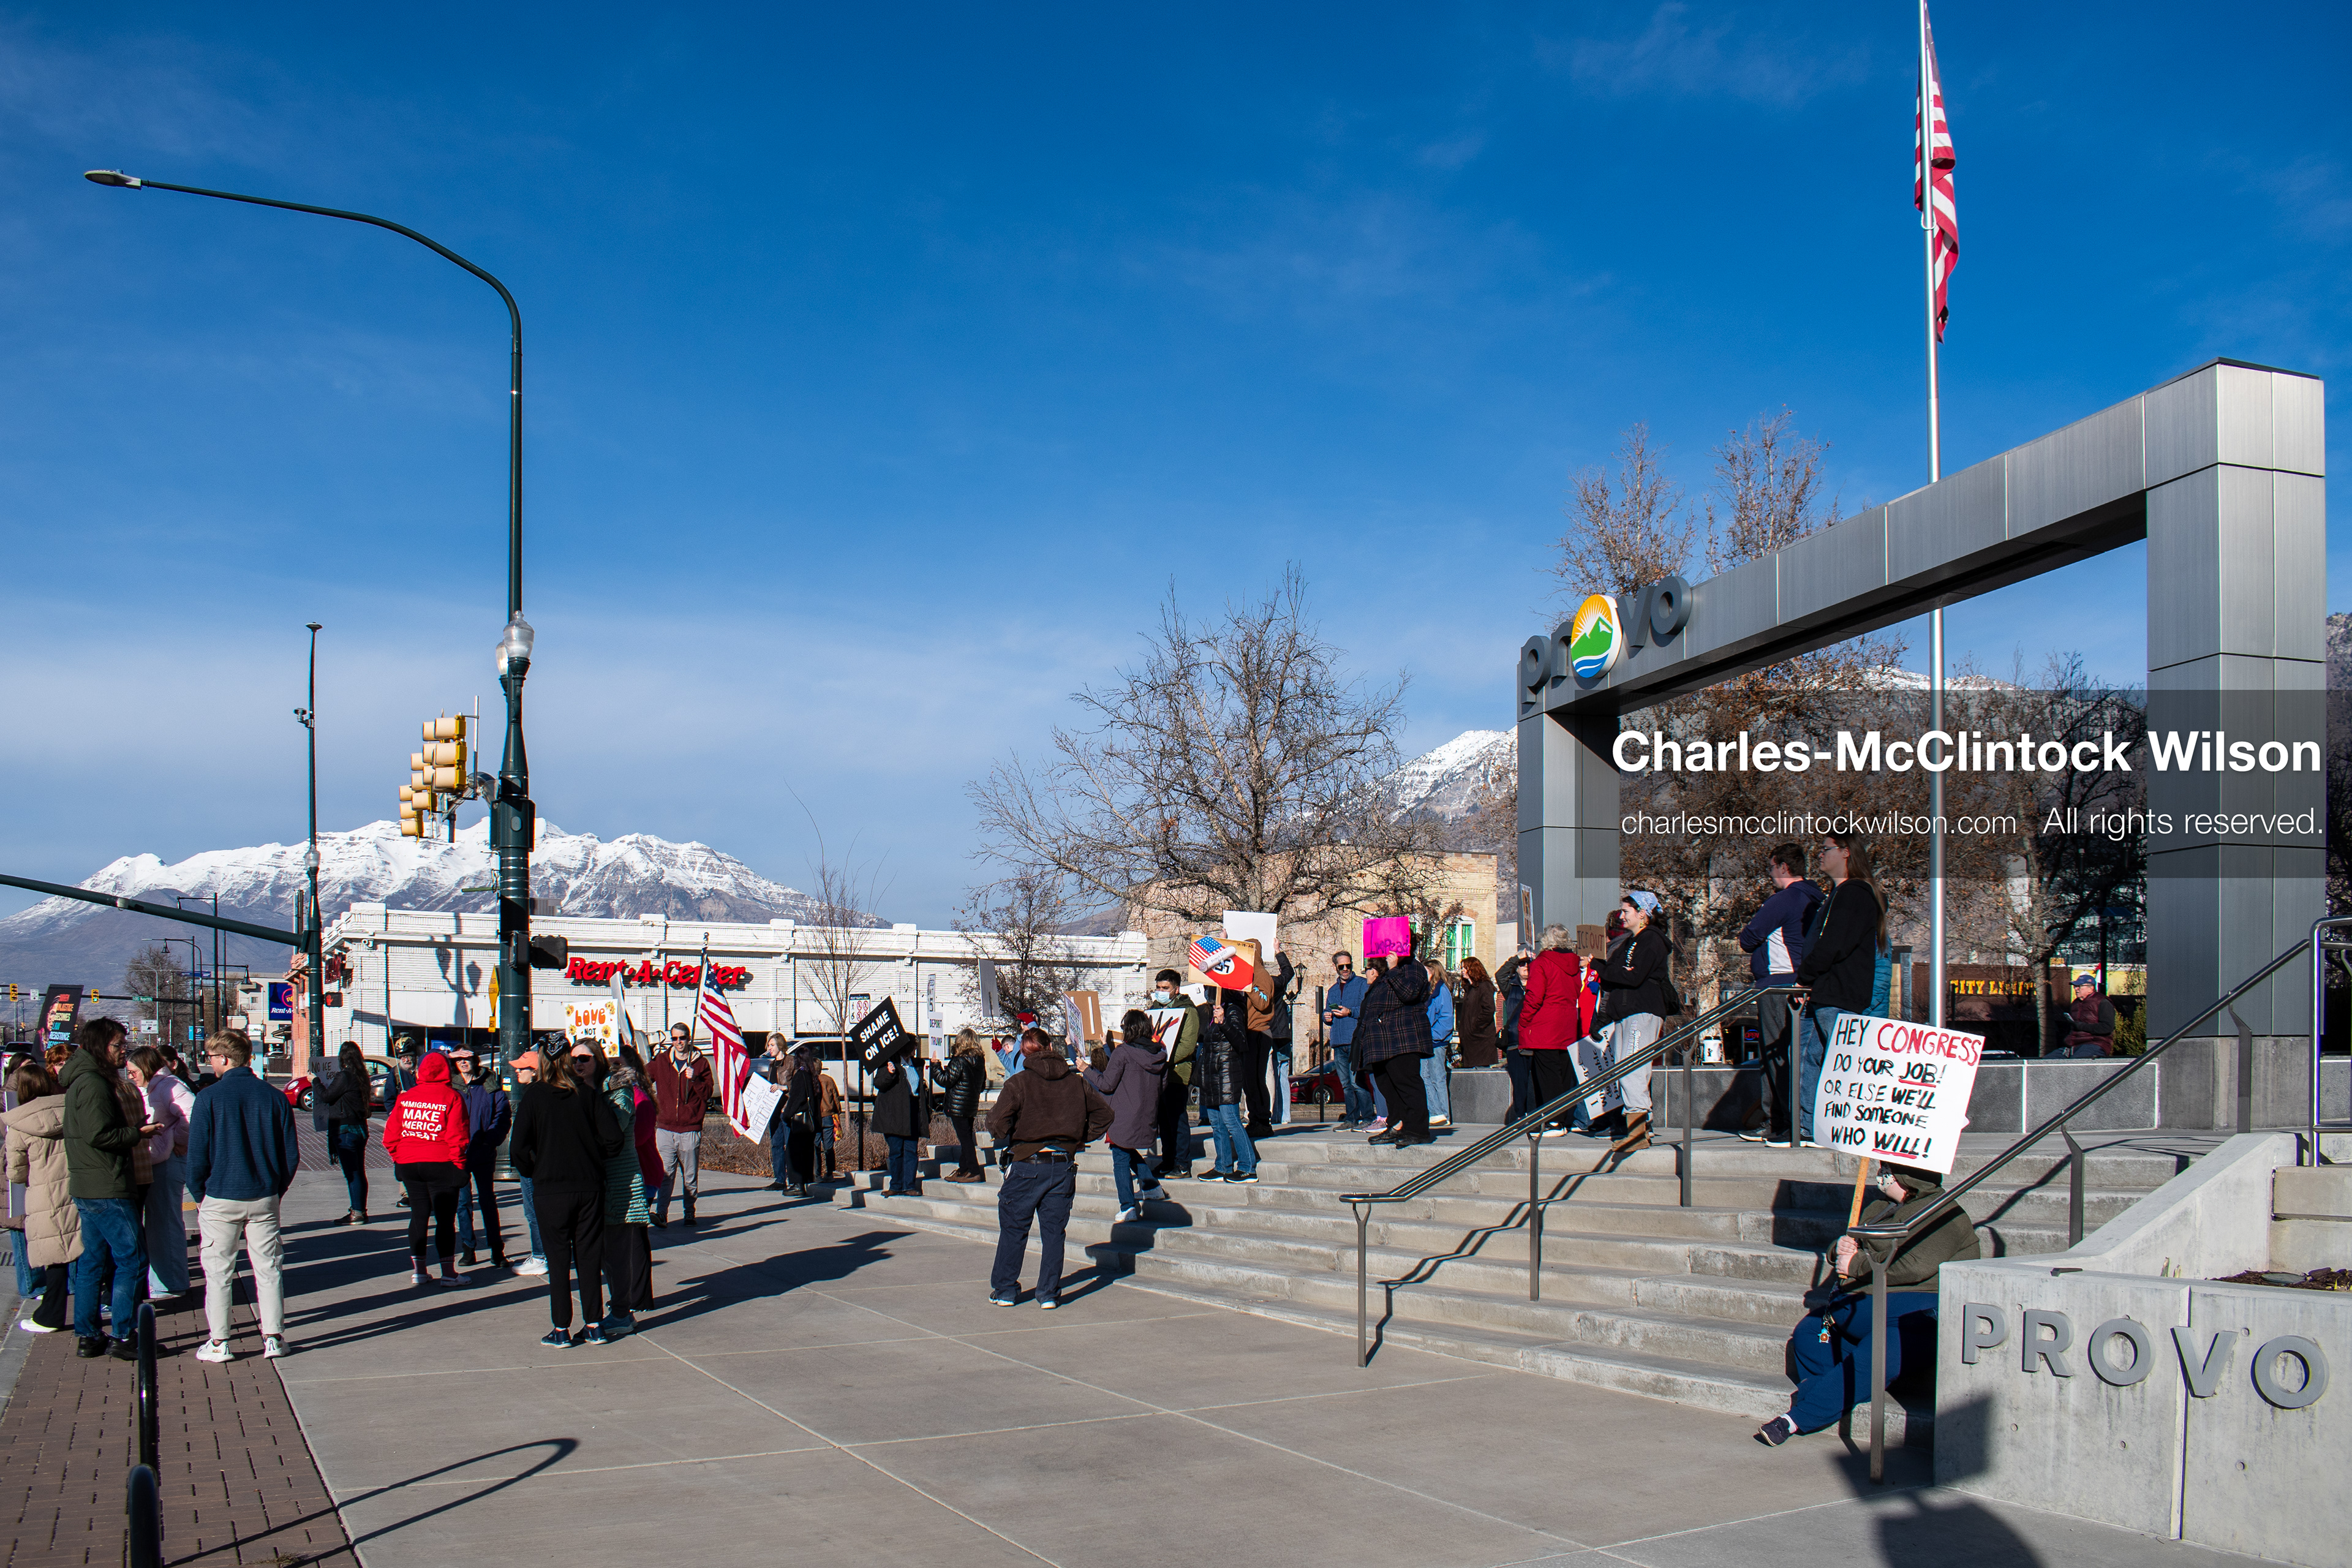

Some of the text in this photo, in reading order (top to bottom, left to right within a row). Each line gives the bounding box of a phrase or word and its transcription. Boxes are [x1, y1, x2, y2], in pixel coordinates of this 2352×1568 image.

[1577, 930, 1604, 952] ICE OUT
[575, 1008, 606, 1027] LOVE
[859, 1010, 891, 1043] SHAME
[865, 1024, 900, 1061] ON ICE!
[930, 1036, 943, 1047] TRUMP
[1835, 1018, 1981, 1066] HEY CONGRESS
[311, 1061, 332, 1073] NO ICE
[1833, 1053, 1947, 1084] DO YOUR JOB!
[754, 1085, 766, 1106] NEW
[1823, 1079, 1936, 1110] OR ELSE WE'LL
[402, 1108, 441, 1123] MAKE
[1823, 1100, 1929, 1129] FIND SOMEONE
[401, 1129, 438, 1141] GREAT
[1831, 1125, 1932, 1158] WHO WILL!
[1961, 1302, 2329, 1410] PROVO
